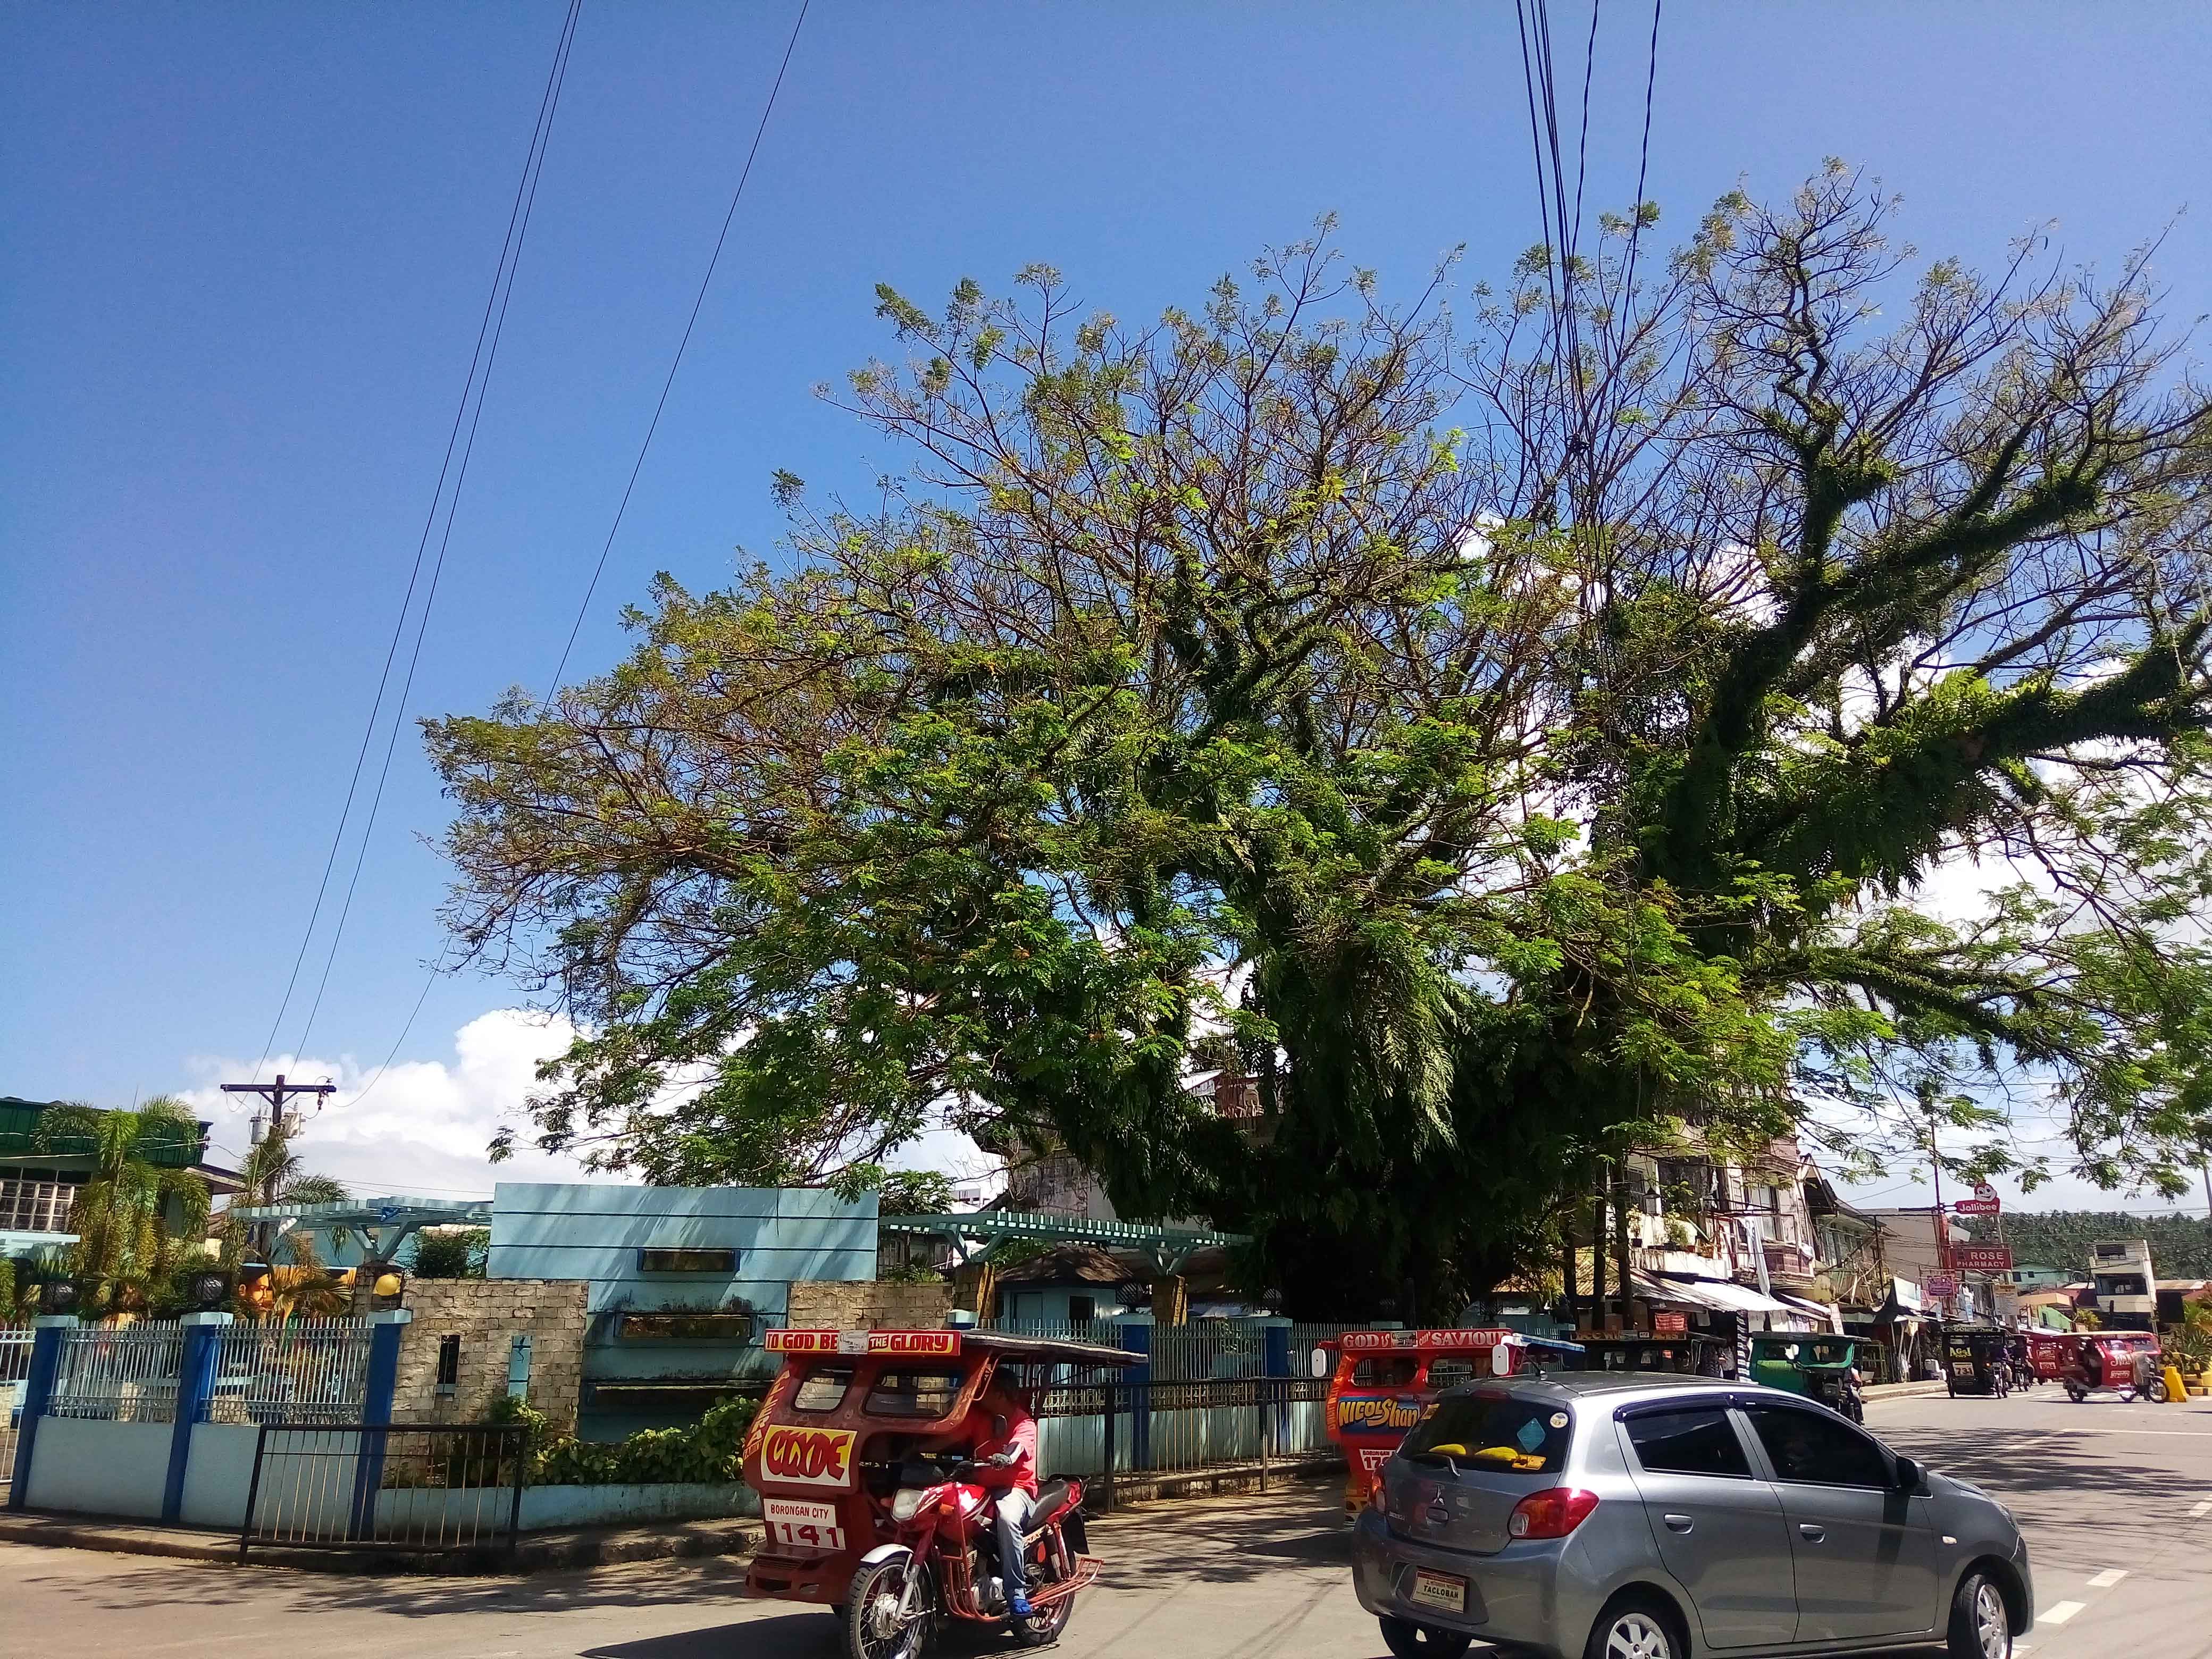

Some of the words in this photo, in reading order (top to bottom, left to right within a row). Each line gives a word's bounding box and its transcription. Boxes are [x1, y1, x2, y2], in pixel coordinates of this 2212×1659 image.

[1960, 1202, 1997, 1212] Jollibee
[1970, 1252, 2004, 1260] ROSE
[783, 1334, 815, 1350] GOD
[819, 1334, 839, 1350] BE
[870, 1337, 887, 1347] THE
[890, 1335, 949, 1351] GLORY
[1343, 1335, 1379, 1347] GOD
[770, 1504, 810, 1516] BORONGAN
[812, 1507, 829, 1519] CITY
[781, 1523, 839, 1548] 141
[1424, 1586, 1459, 1598] TACLOBAN
